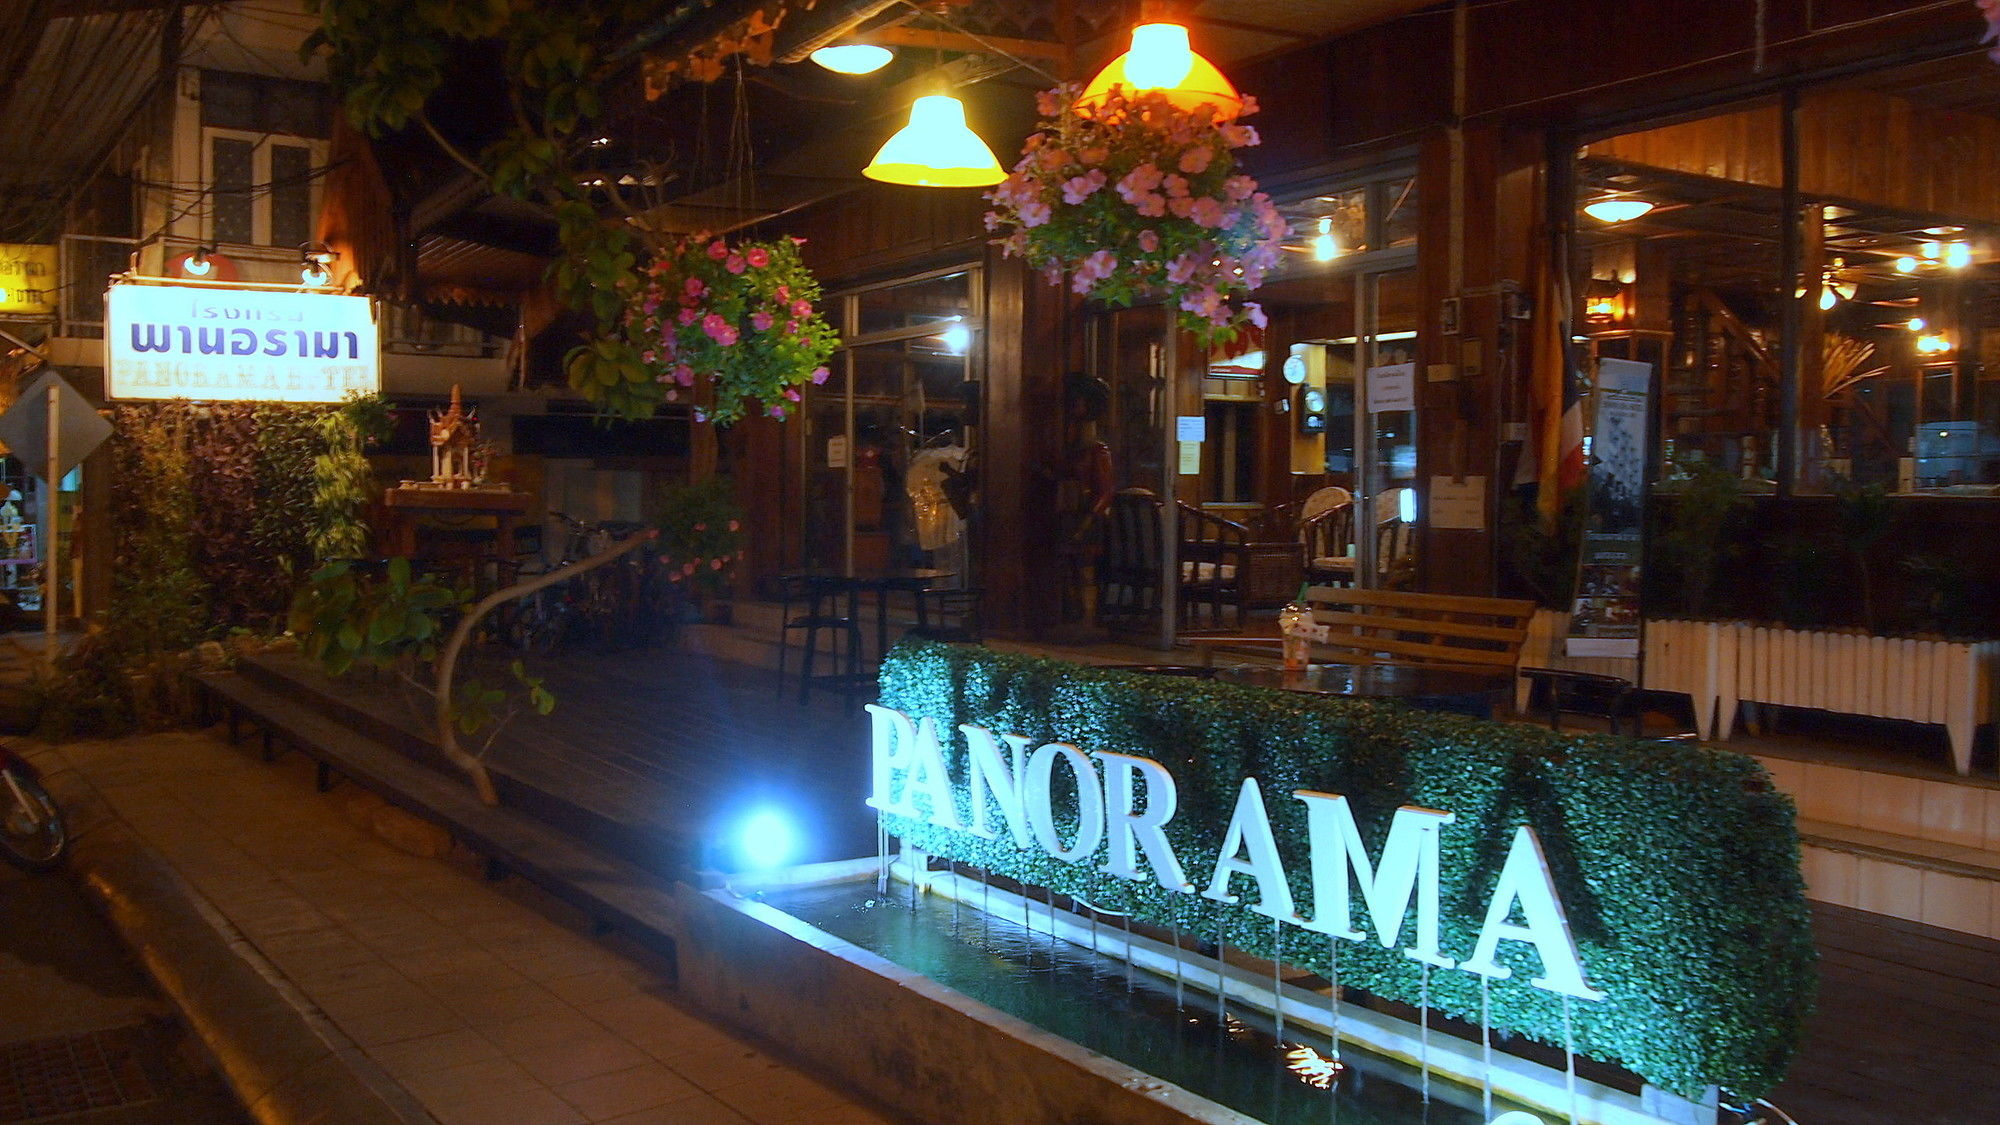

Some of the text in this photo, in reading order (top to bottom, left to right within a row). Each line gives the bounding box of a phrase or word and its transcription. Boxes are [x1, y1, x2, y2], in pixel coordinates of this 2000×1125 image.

[130, 322, 359, 360] พานอรามา
[864, 703, 1608, 1003] PANORAMA
